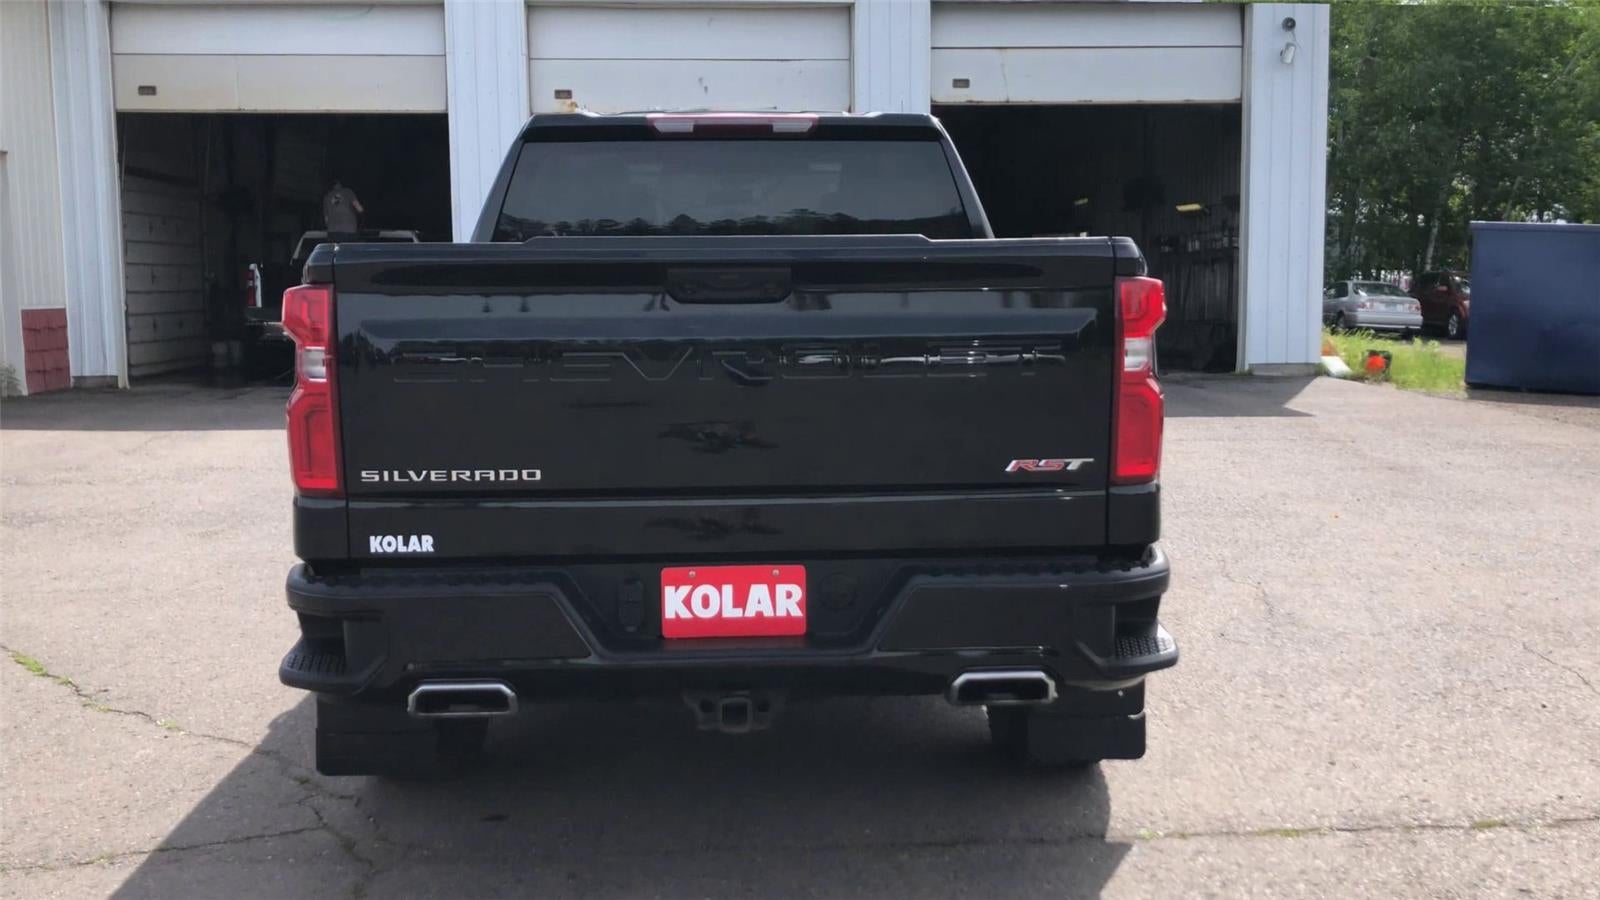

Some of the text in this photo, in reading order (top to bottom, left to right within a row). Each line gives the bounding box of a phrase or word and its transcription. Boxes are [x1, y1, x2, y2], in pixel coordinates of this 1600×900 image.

[391, 341, 1067, 383] CHEVROLET
[1005, 458, 1094, 472] RST
[360, 469, 542, 482] SILVERADO
[369, 534, 434, 553] KOLAR
[664, 583, 803, 619] KOLAR
